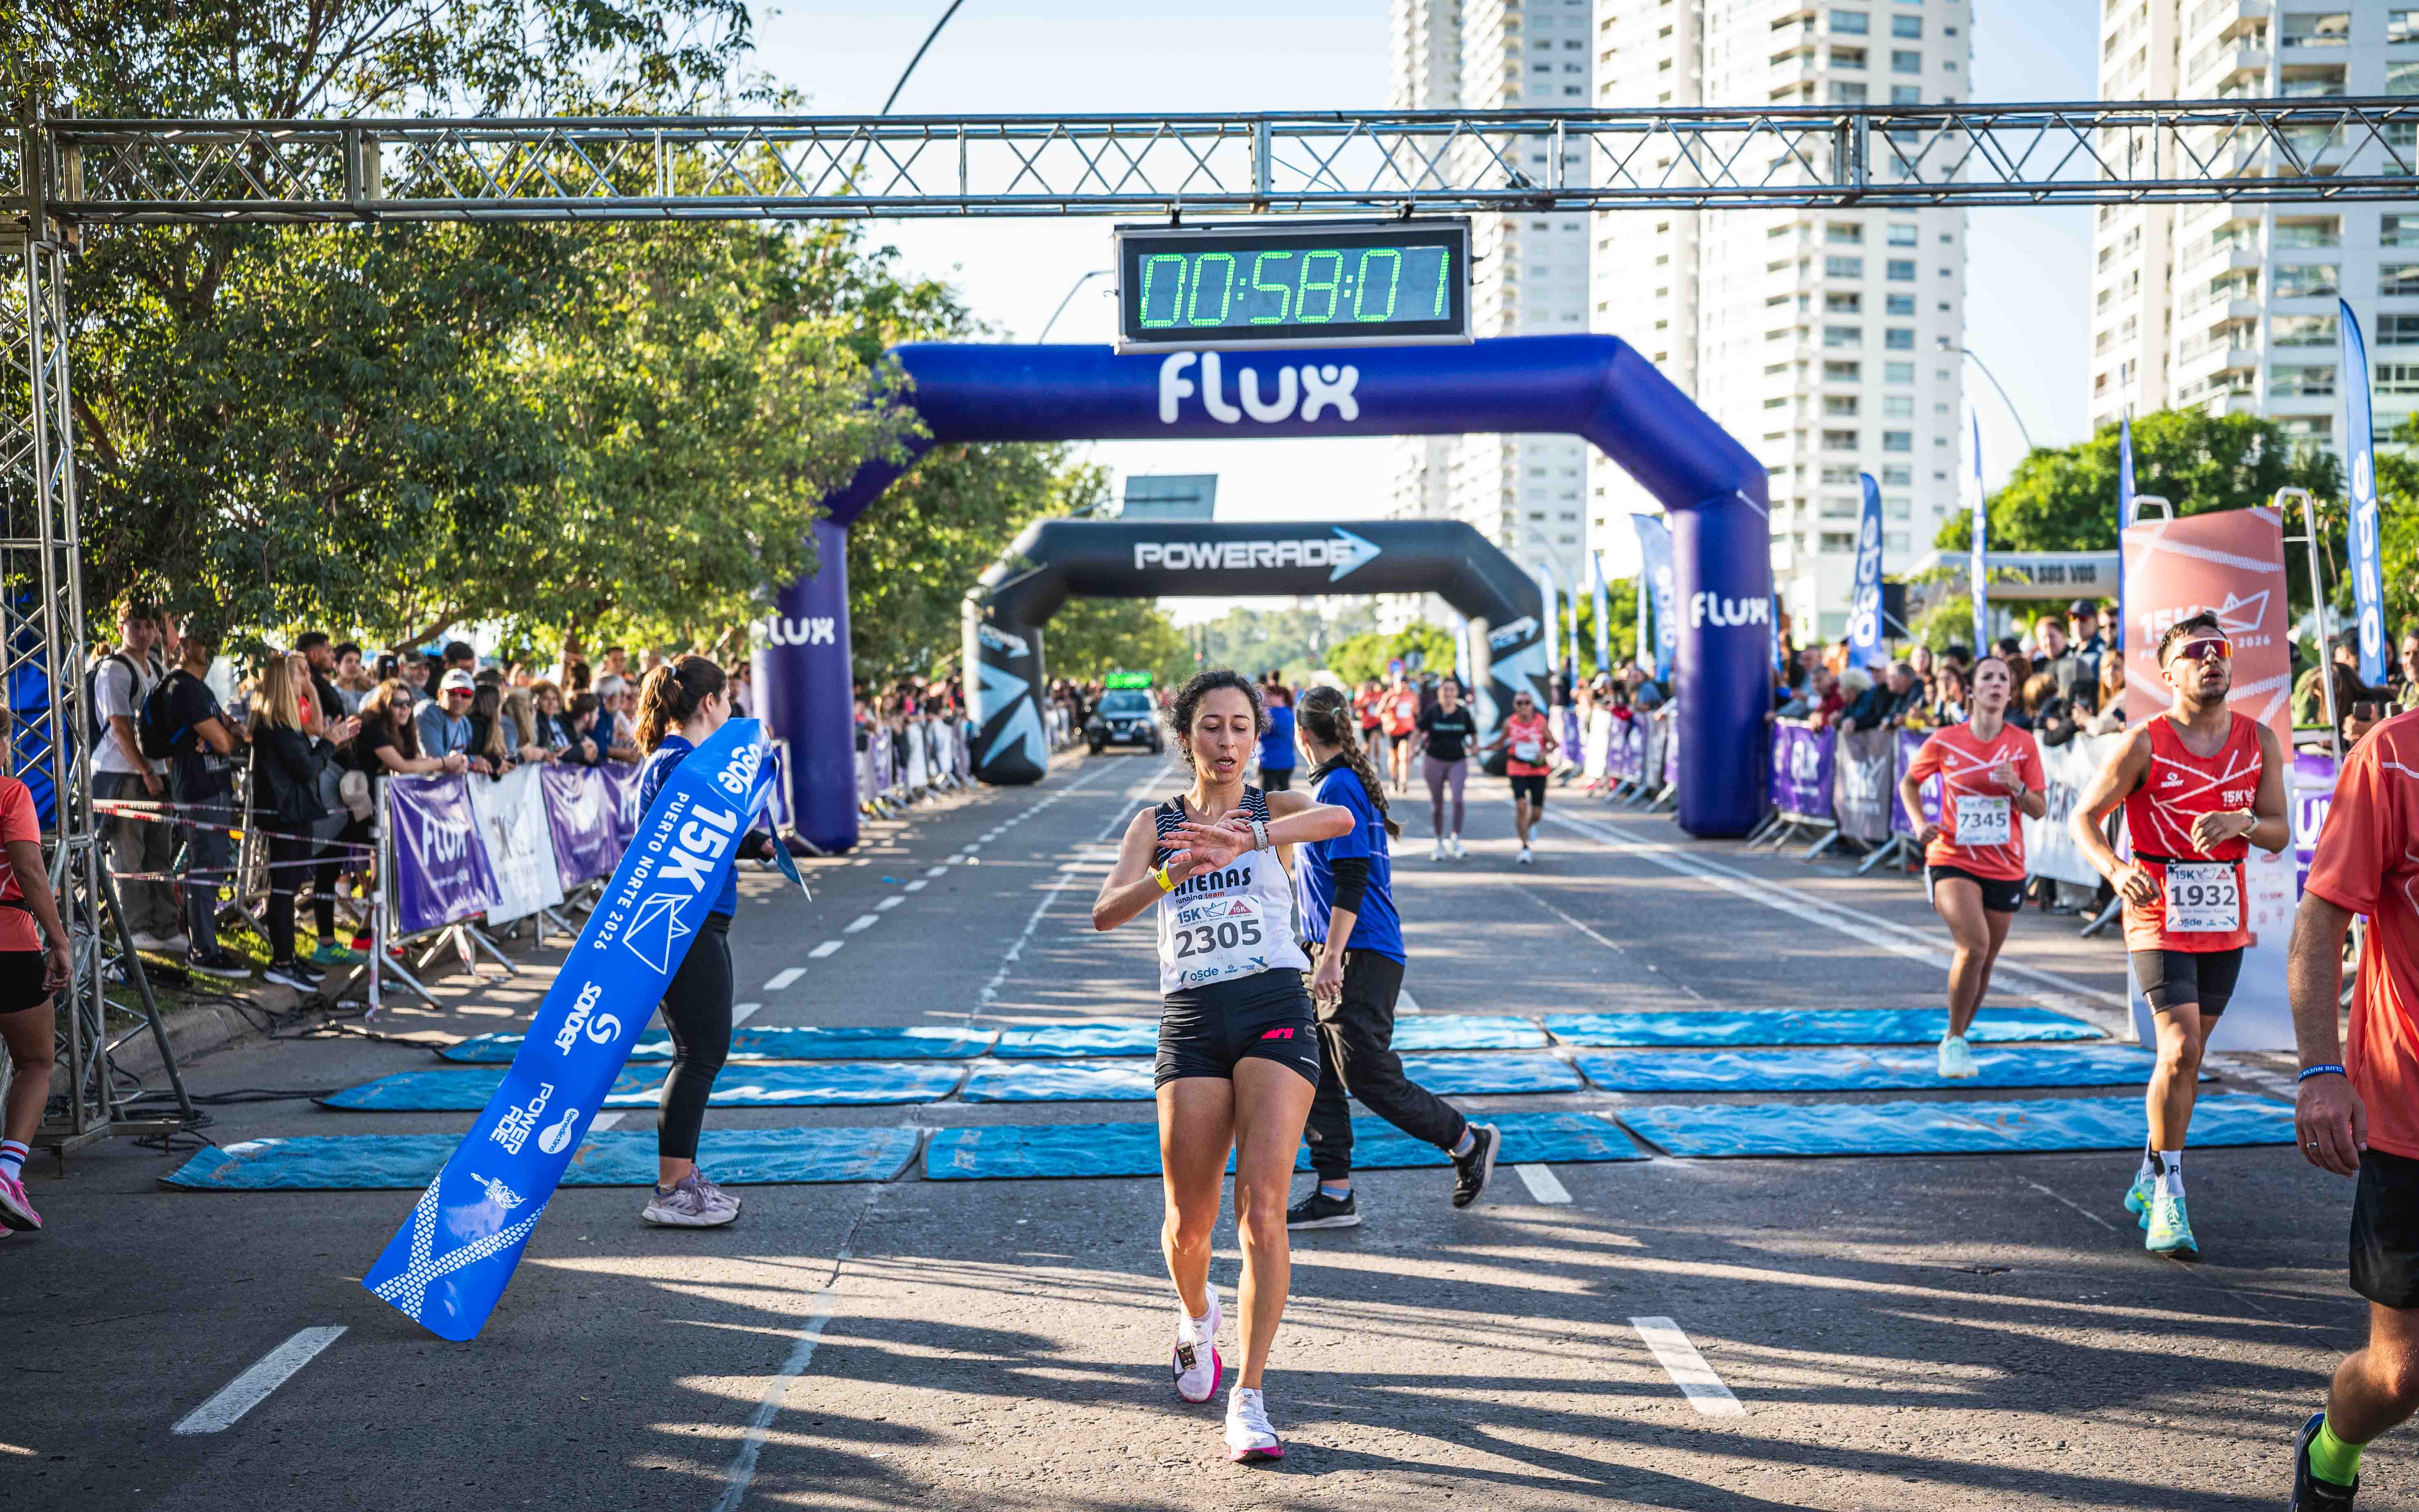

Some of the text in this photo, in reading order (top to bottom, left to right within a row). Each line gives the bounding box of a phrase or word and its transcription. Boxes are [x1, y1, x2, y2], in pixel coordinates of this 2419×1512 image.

[1140, 249, 1450, 328] 00:58:01
[1134, 539, 1356, 570] POWERADE
[648, 791, 690, 851] PUERTO
[1959, 813, 2006, 828] 7345
[658, 804, 738, 893] 15K
[617, 856, 654, 908] NORTE
[1176, 894, 1203, 905] running
[2171, 885, 2236, 906] 1932
[593, 910, 623, 950] 2026
[1177, 907, 1202, 924] 15K
[1175, 919, 1262, 959] 2305
[1190, 967, 1219, 981] osde
[2303, 1067, 2323, 1075] NUEVA
[503, 1082, 554, 1155] POWER
[549, 1111, 576, 1152] benedictino
